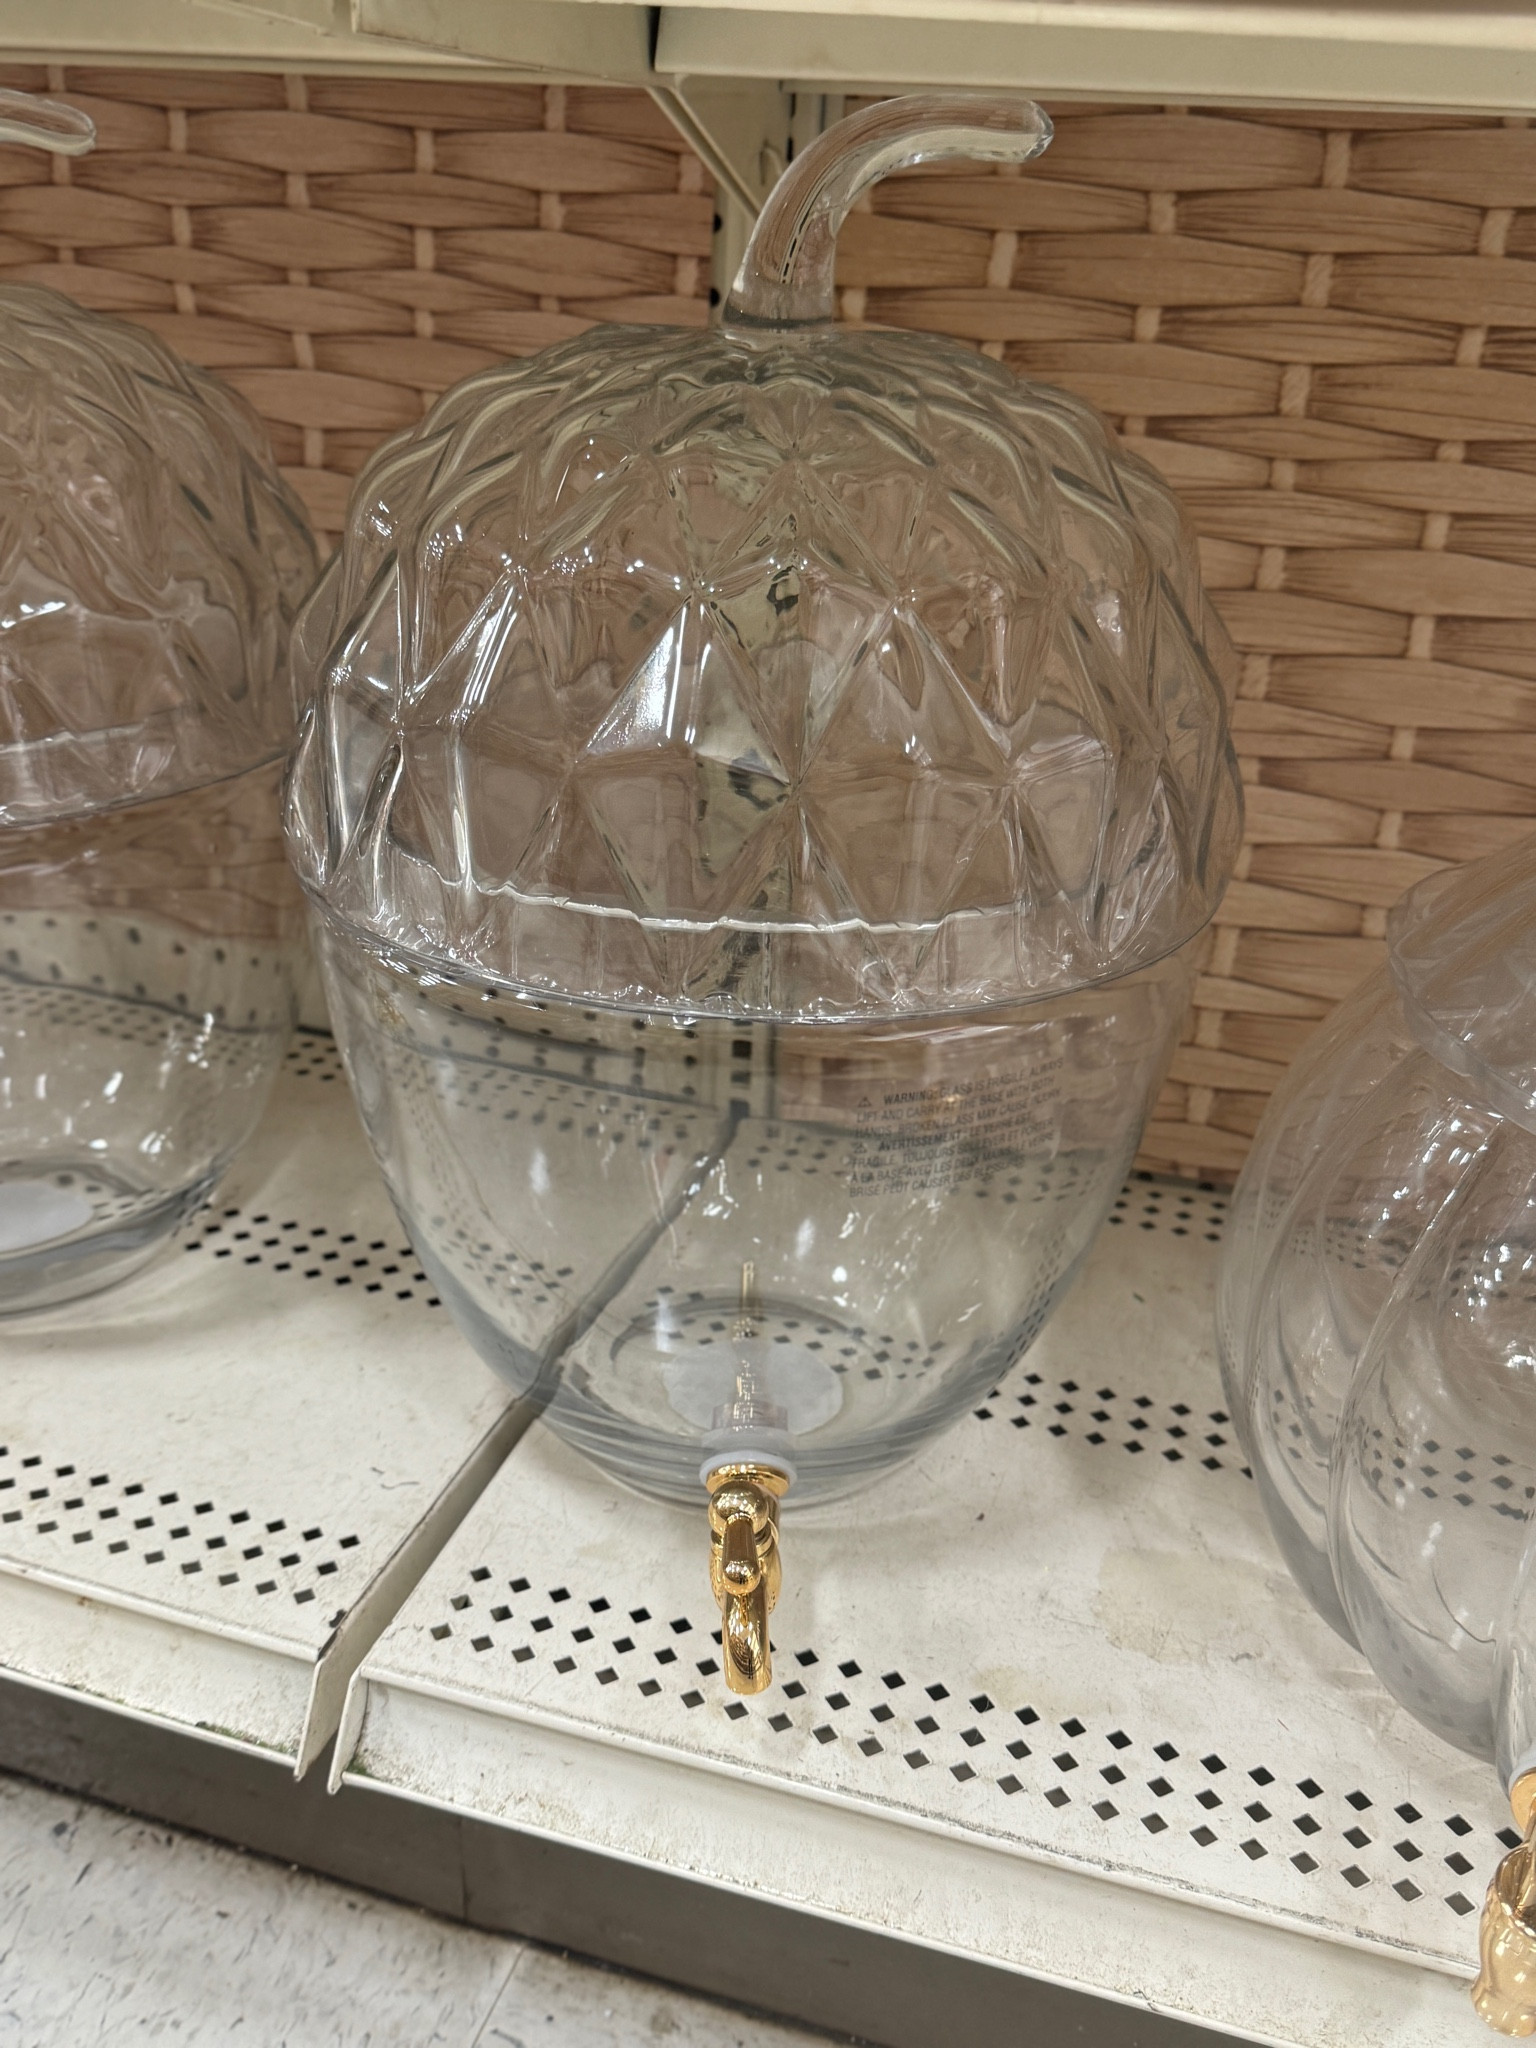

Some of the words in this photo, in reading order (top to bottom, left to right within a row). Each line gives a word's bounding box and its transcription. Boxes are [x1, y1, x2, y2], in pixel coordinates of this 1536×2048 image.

[857, 1111, 877, 1123] LIFT
[881, 1109, 904, 1120] AND
[907, 1104, 941, 1118] CARRY
[944, 1103, 955, 1114] AT
[960, 1097, 976, 1110] THE
[979, 1090, 1004, 1105] BASE
[1006, 1083, 1030, 1098] WITH
[1031, 1075, 1055, 1091] BOTH
[940, 1082, 973, 1098] GLASS
[975, 1079, 984, 1091] IS
[898, 1119, 940, 1134] BROKEN
[943, 1112, 975, 1128] GLASS
[977, 1108, 997, 1121] MAY
[999, 1097, 1029, 1115] CAUSE
[878, 1129, 961, 1151] AVERTISSEMENT
[970, 1125, 980, 1138] LE
[877, 1166, 902, 1181] BASE
[934, 1160, 952, 1173] LES
[912, 1177, 950, 1191] CAUSER
